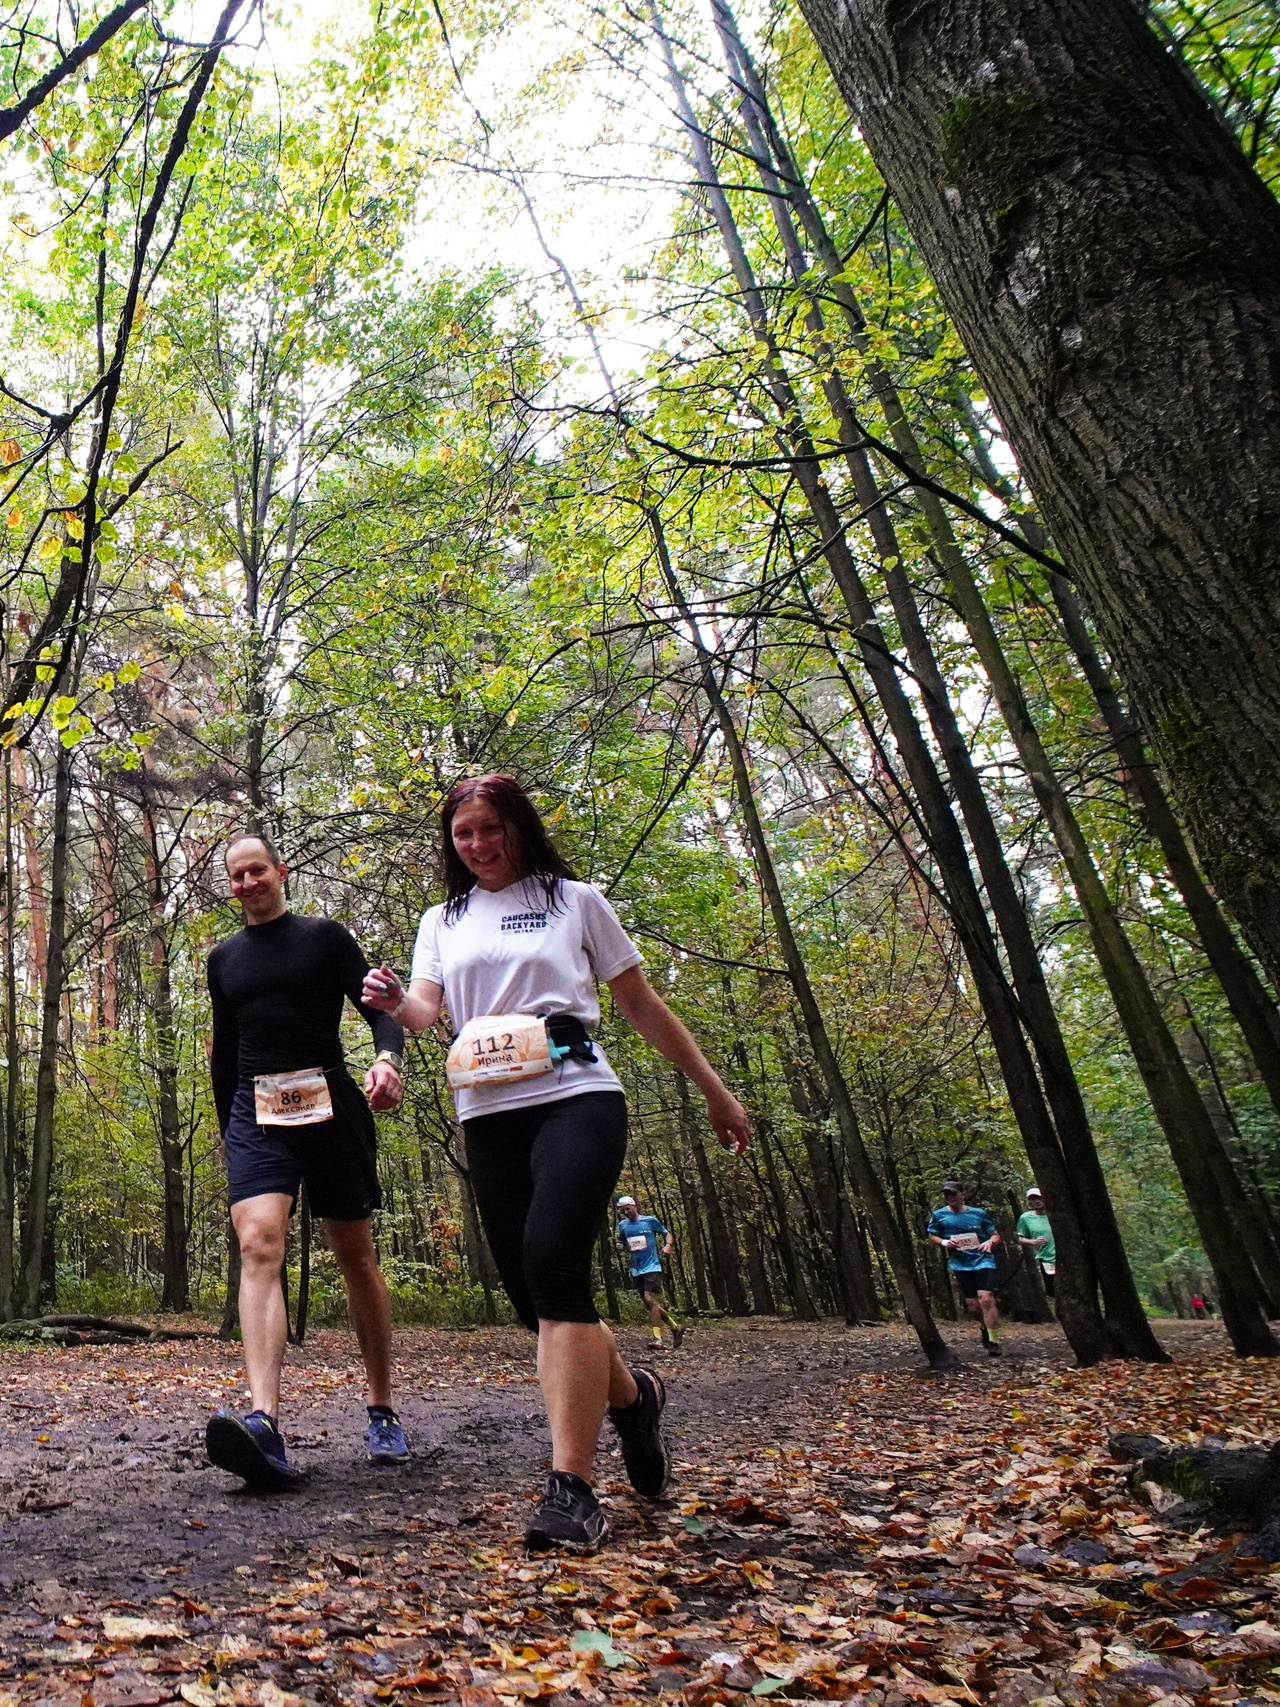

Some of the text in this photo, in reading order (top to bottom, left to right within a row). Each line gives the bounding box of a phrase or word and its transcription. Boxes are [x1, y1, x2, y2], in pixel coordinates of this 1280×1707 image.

[501, 913, 547, 922] CAUCASUS
[501, 921, 547, 931] BACKYARD
[472, 1032, 516, 1056] 112
[280, 1090, 302, 1105] 86
[271, 1103, 316, 1115] Александр
